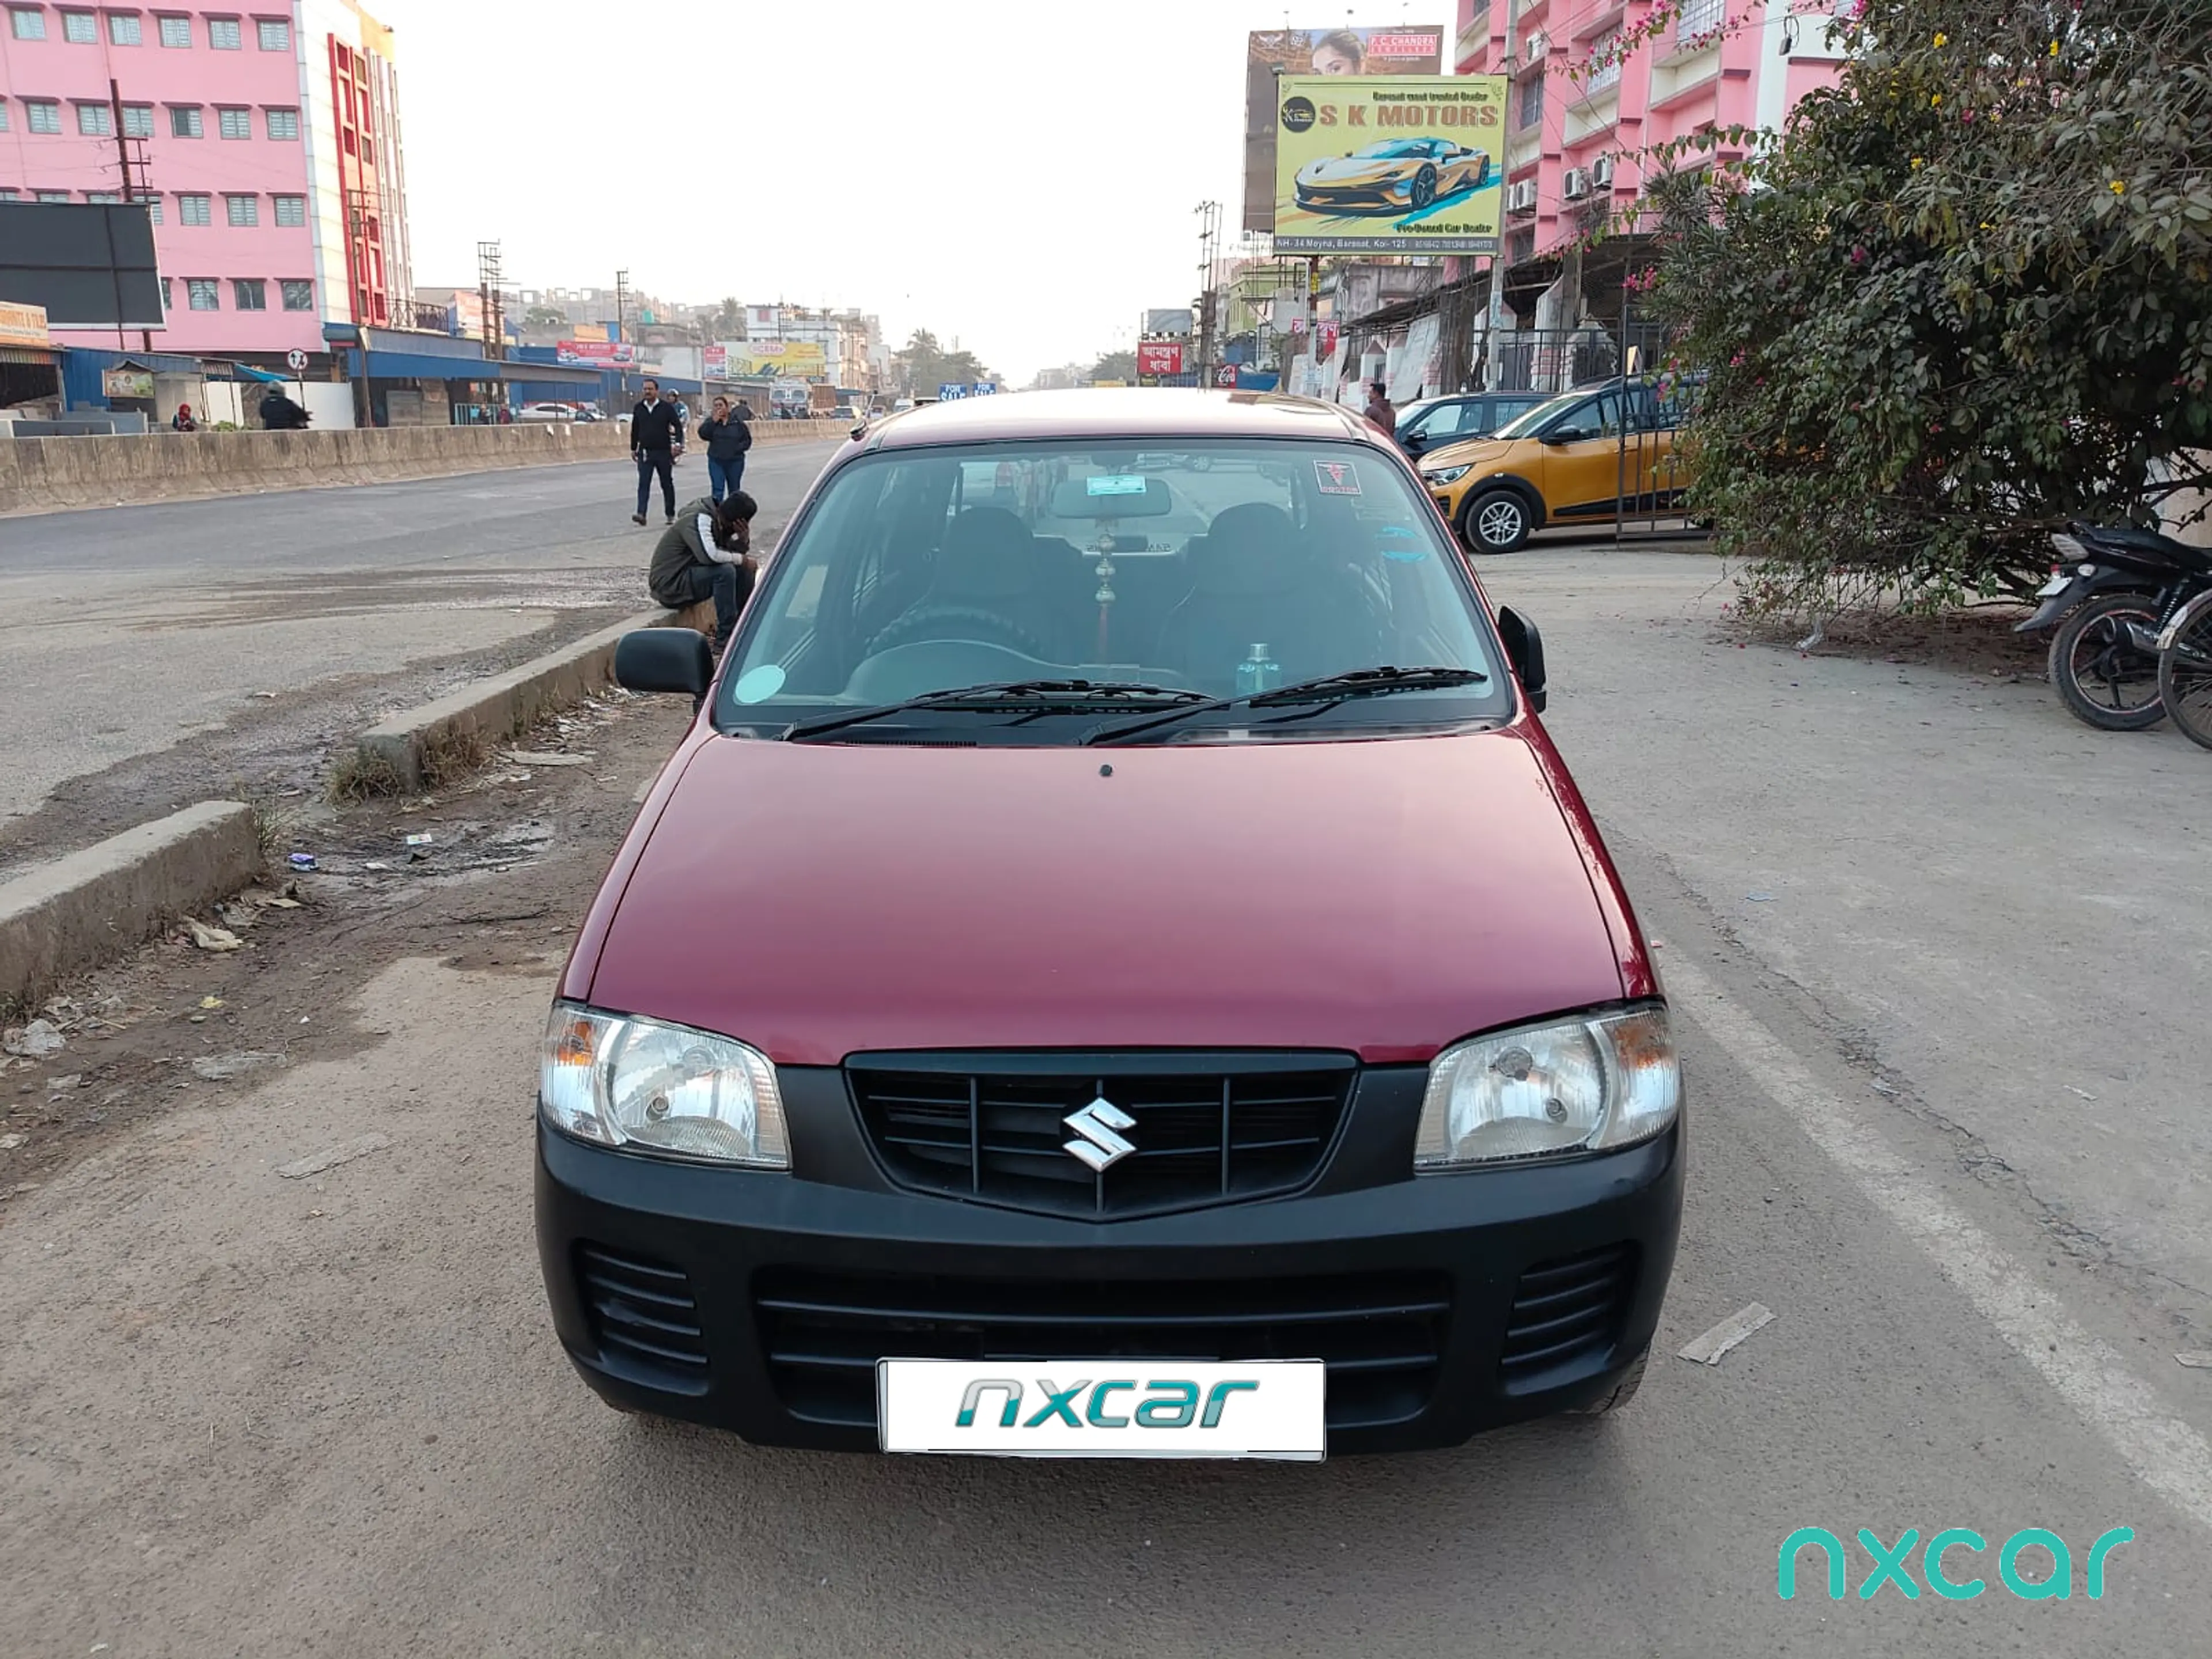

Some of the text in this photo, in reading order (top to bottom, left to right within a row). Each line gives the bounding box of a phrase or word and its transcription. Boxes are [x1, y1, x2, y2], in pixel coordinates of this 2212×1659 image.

[1392, 36, 1434, 45] CHANDRA
[1320, 105, 1498, 127] S K MOTORS
[941, 392, 966, 402] SALE
